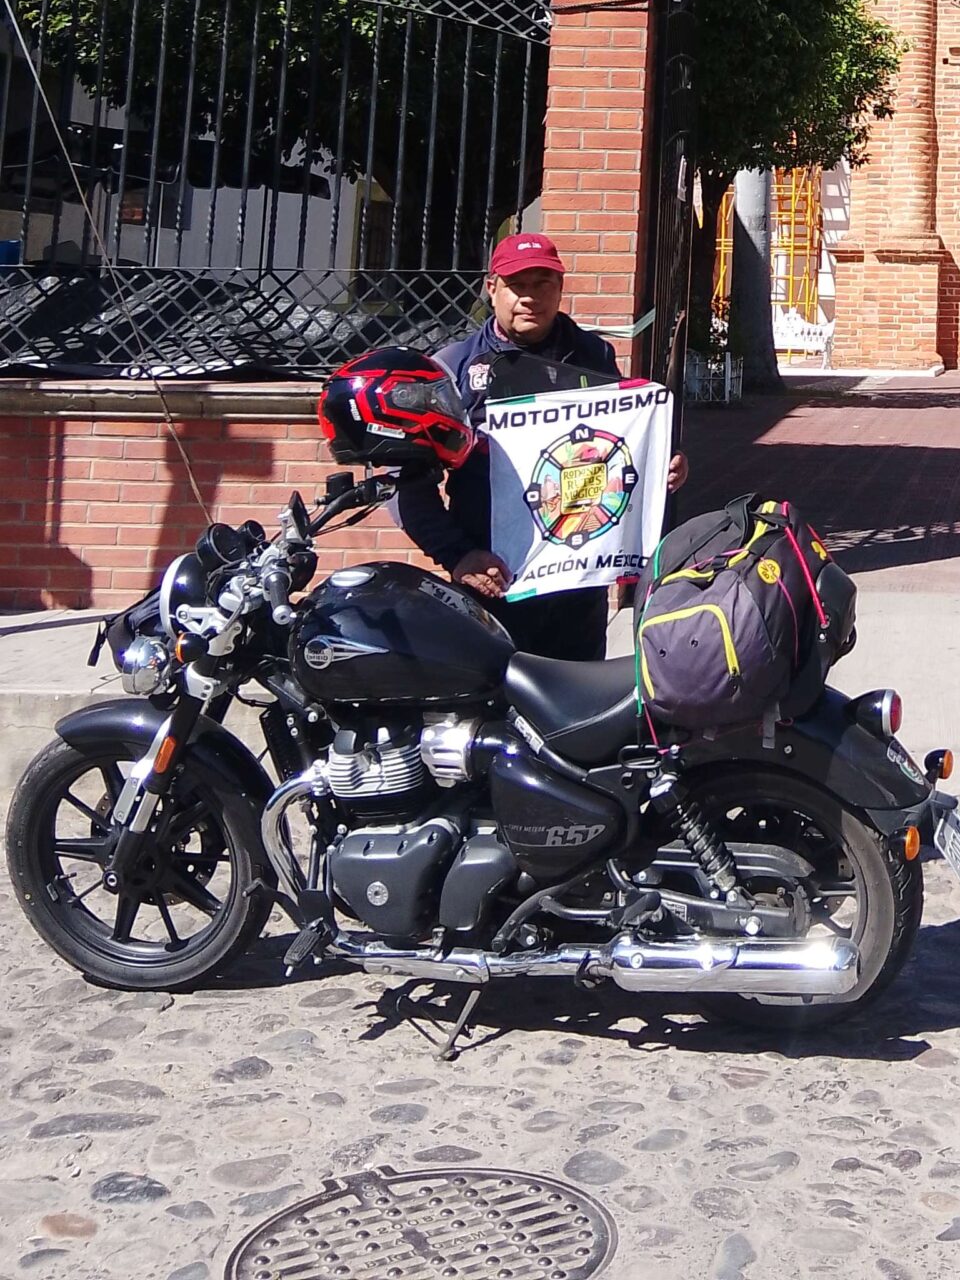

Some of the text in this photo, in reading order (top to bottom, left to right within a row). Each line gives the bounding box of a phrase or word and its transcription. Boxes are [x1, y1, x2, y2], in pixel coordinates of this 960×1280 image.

[488, 388, 670, 431] MOTOTURISMO
[575, 428, 589, 440] N
[625, 473, 635, 484] E
[571, 534, 583, 546] S
[523, 554, 588, 582] ACCIÓN
